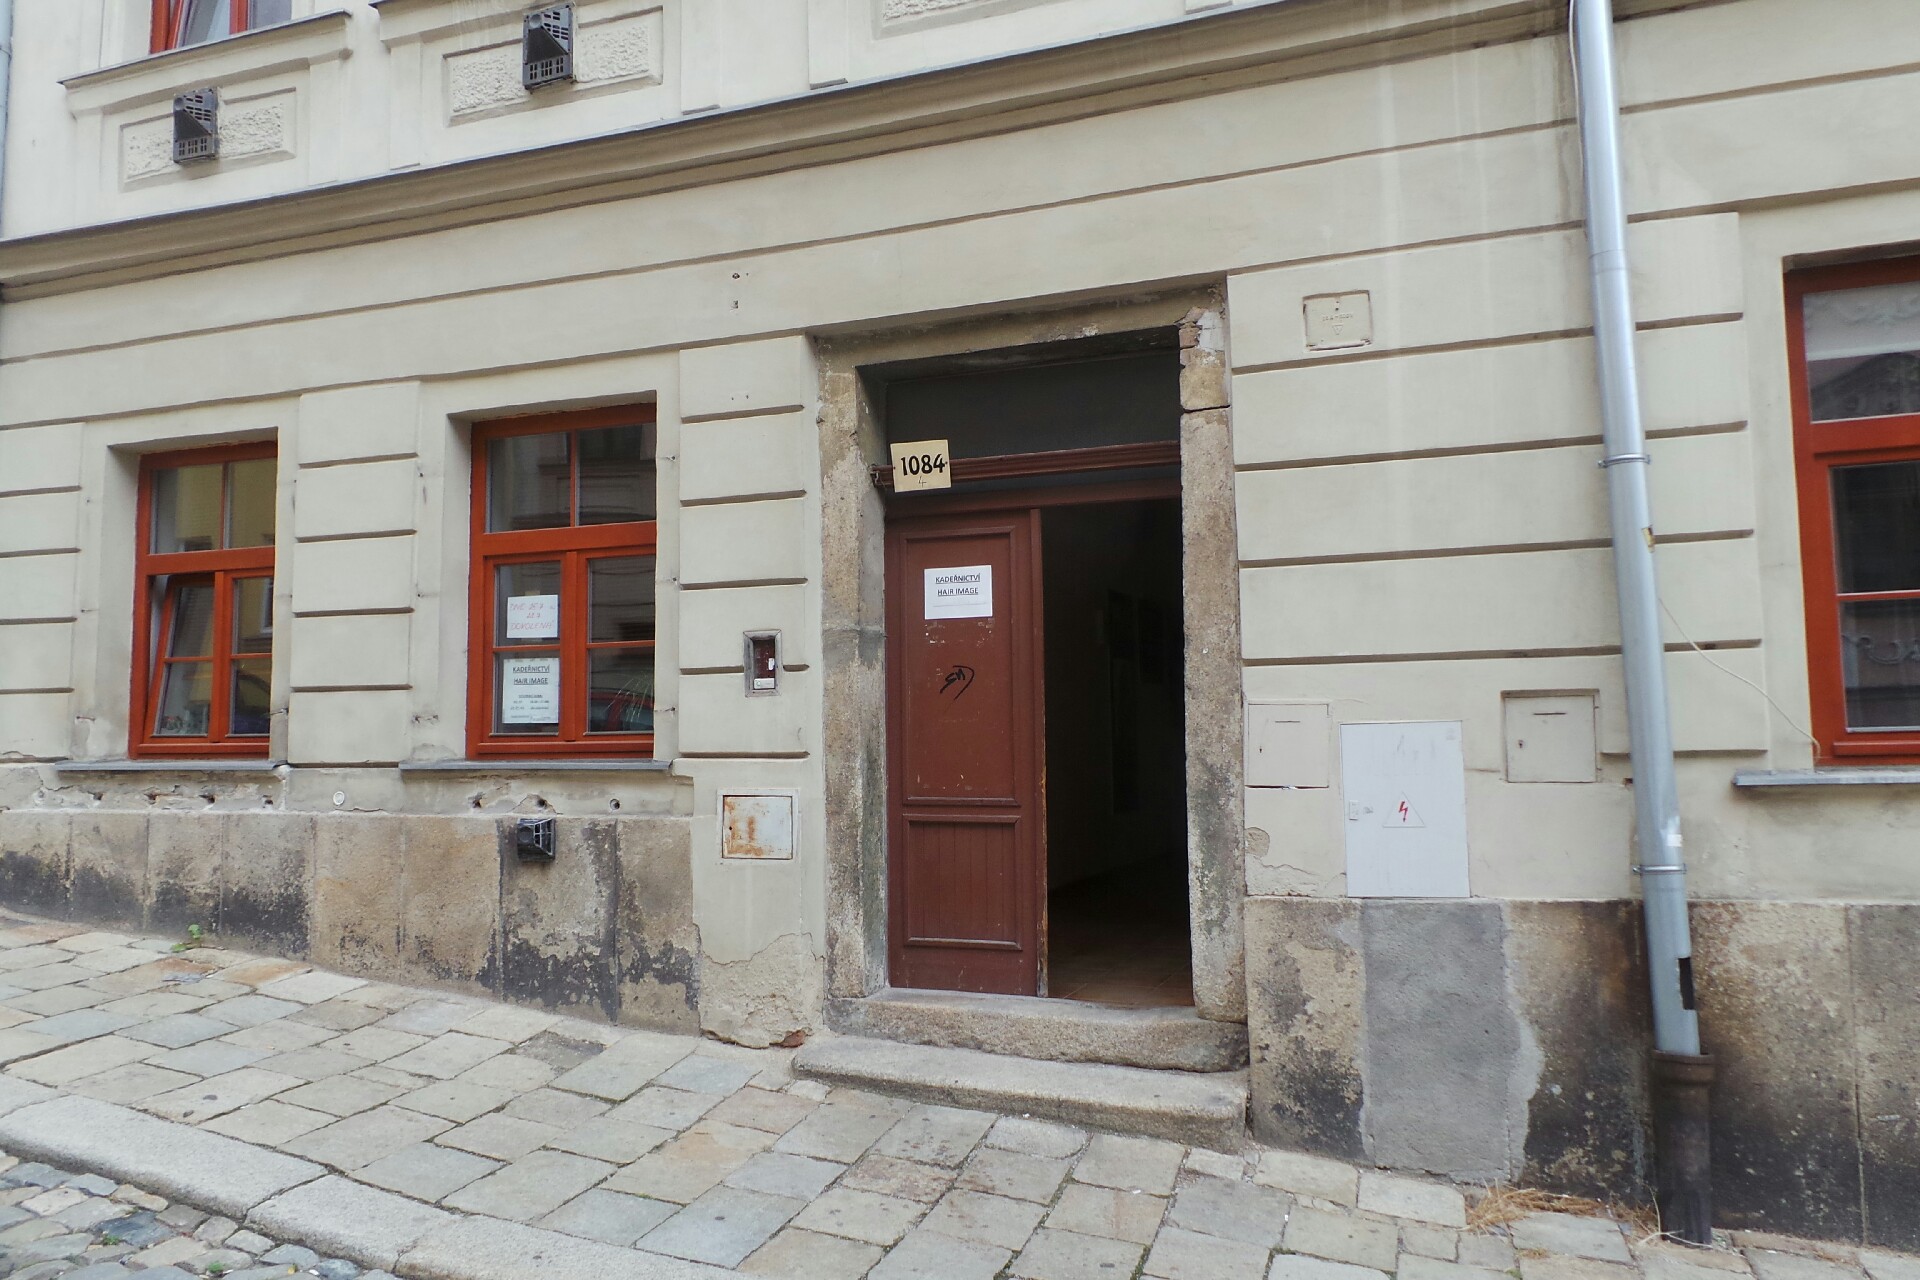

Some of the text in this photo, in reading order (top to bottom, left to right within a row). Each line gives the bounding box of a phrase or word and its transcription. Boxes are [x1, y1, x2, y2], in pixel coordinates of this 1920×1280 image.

[901, 453, 945, 476] 1084
[935, 572, 981, 583] KADEŘNICTVÍ
[938, 587, 979, 596] HAIR IMAGE
[512, 664, 550, 673] KADEŘNICTVÍ
[513, 677, 528, 685] HAIR
